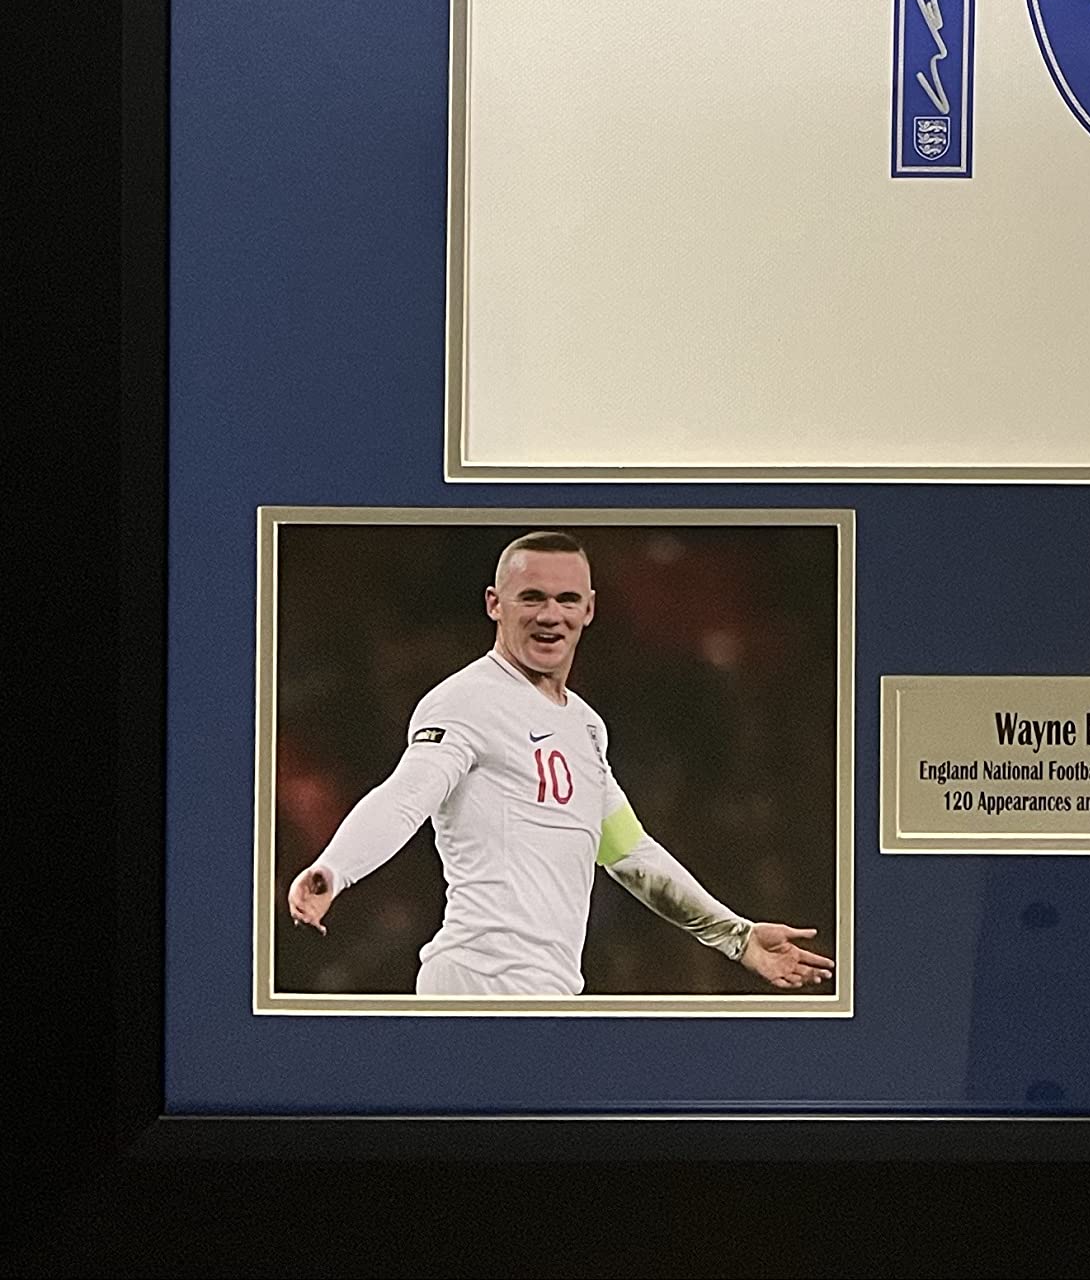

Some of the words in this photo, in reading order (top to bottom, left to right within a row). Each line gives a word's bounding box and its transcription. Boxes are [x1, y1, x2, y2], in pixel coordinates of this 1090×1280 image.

[995, 712, 1077, 754] Wayne
[534, 748, 574, 805] 10
[919, 760, 978, 785] England
[983, 760, 1043, 780] National
[943, 791, 973, 811] 120
[977, 791, 1072, 816] Appearances
